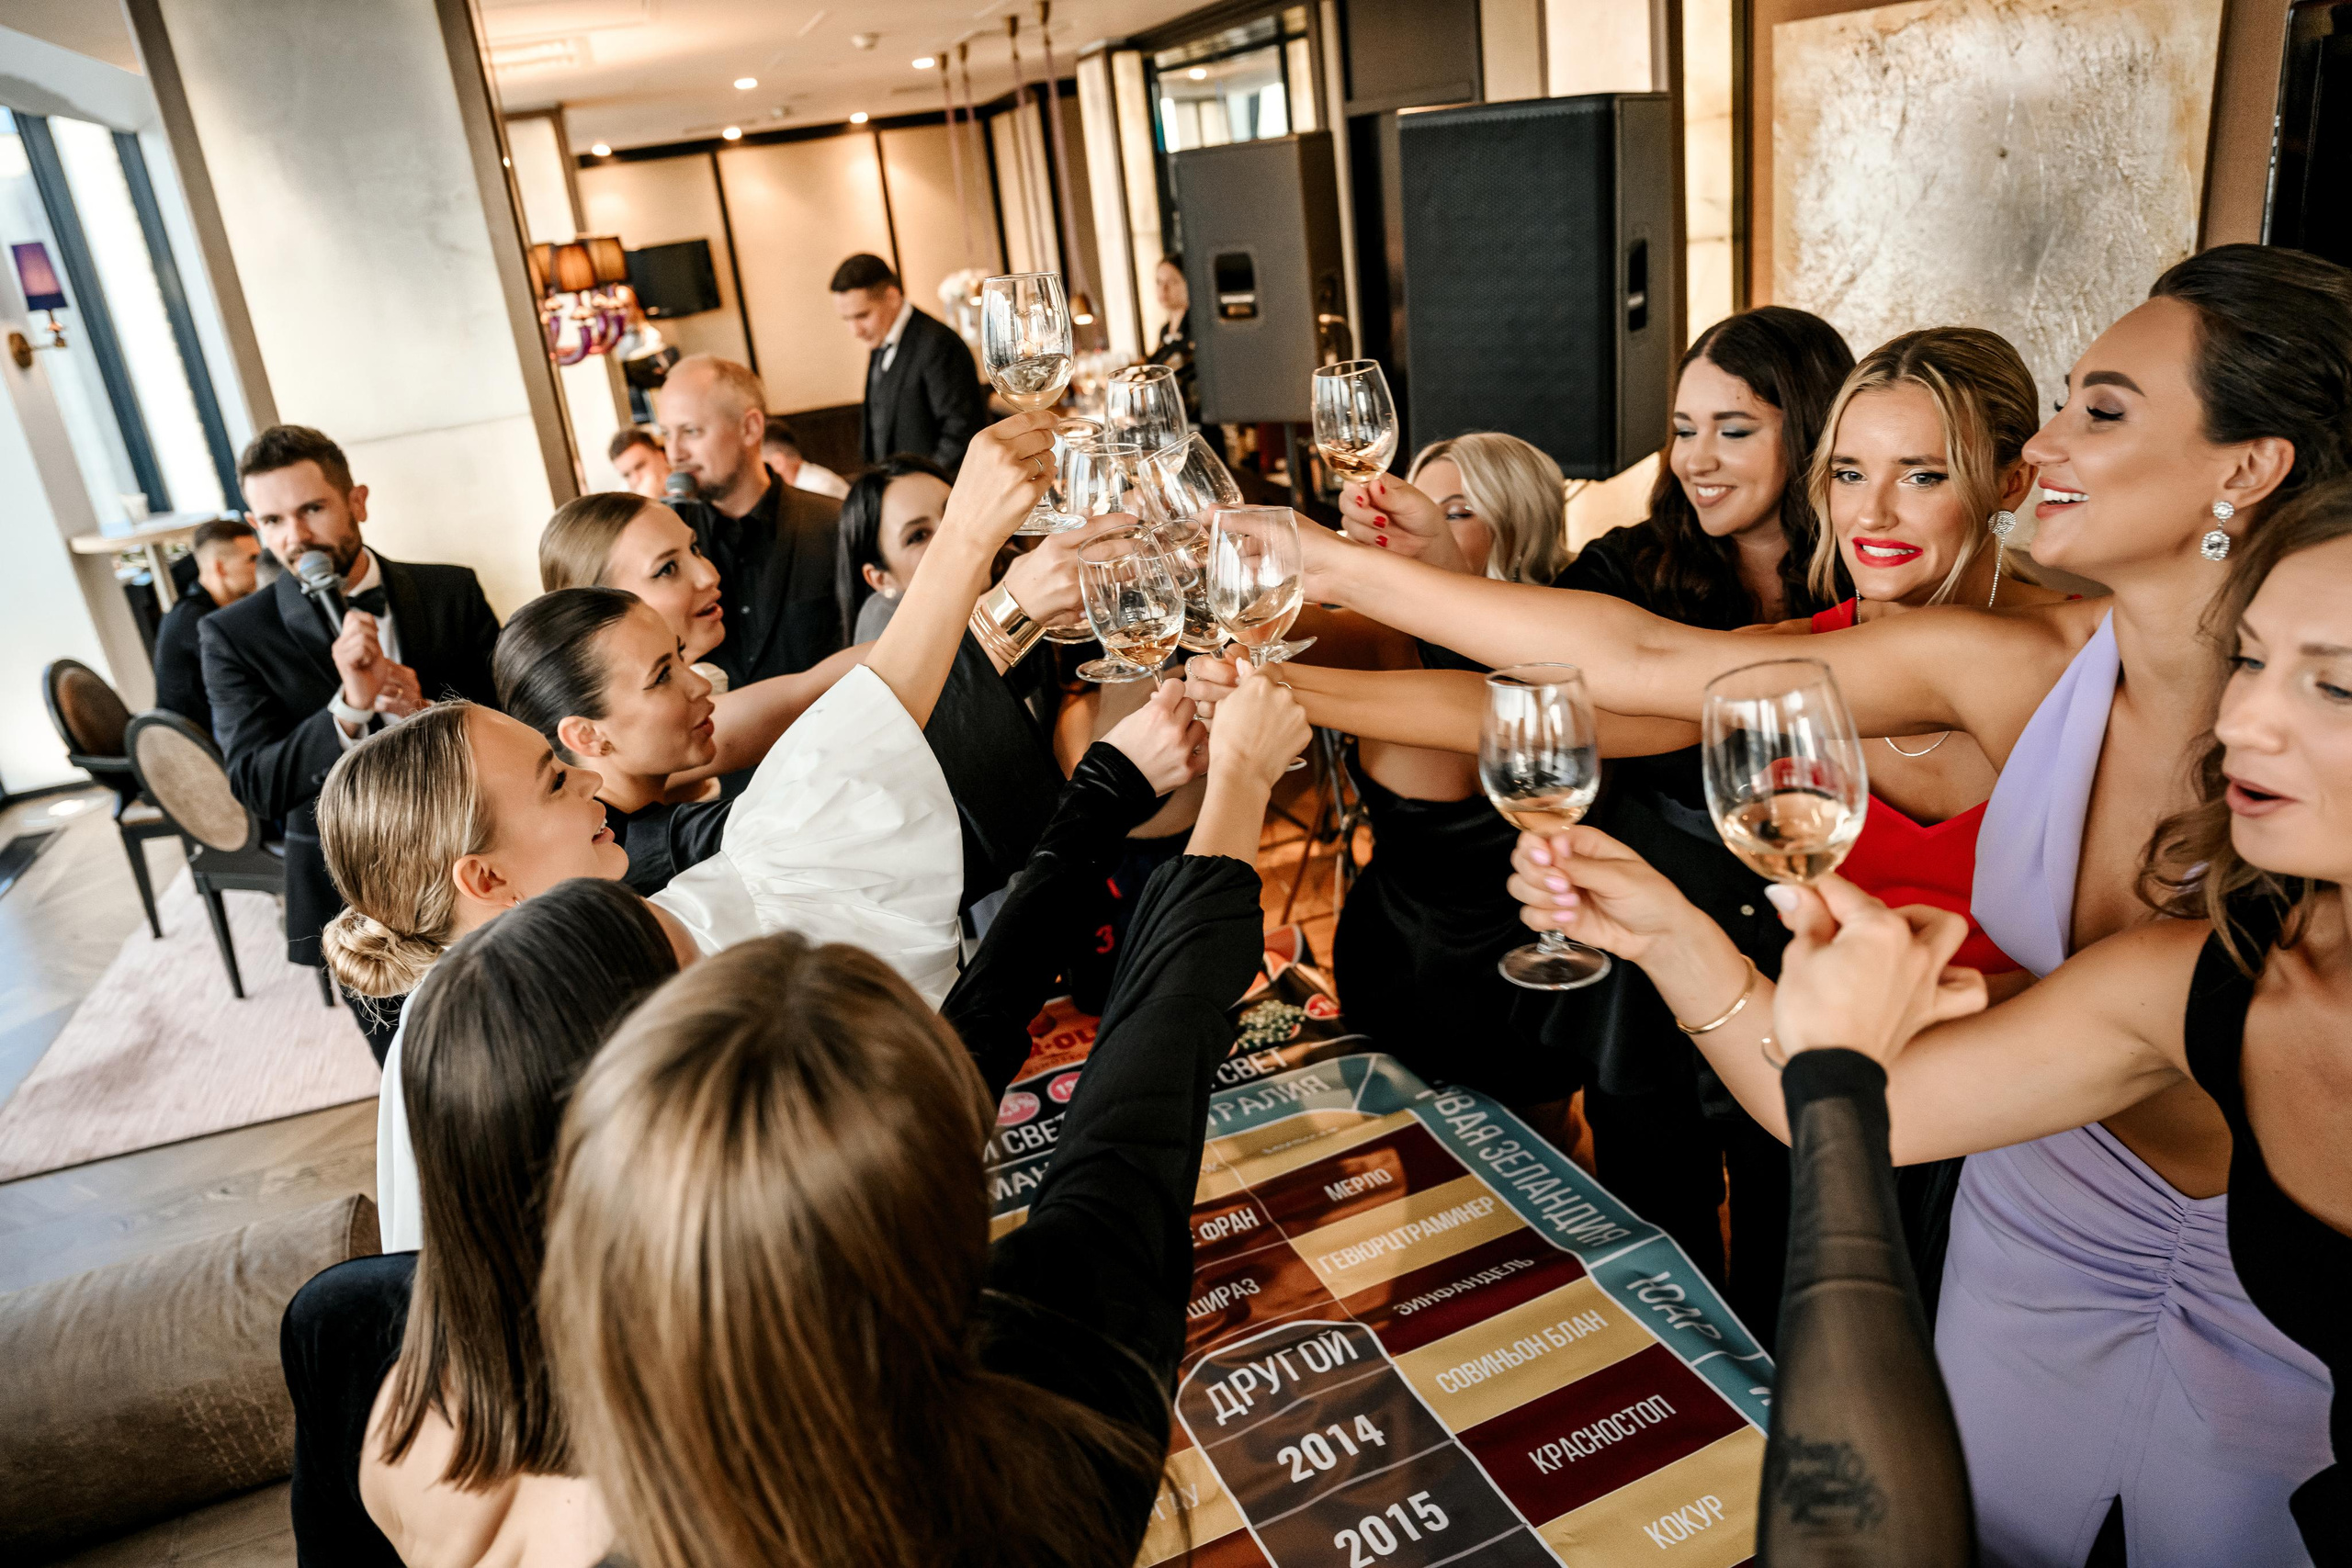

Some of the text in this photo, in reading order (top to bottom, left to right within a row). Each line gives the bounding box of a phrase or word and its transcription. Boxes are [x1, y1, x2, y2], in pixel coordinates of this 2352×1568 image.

[1216, 1046, 1287, 1085] СВЕТ
[1324, 1168, 1393, 1201] МЕРЛО
[1478, 1140, 1632, 1247] ЗЕЛАНДИЯ
[1198, 1207, 1261, 1241] ФРАН
[1317, 1196, 1495, 1274] ГЕВЮРЦТРАМИНЕР
[1186, 1278, 1261, 1319] ШИРАЗ
[1393, 1258, 1535, 1315] ЗИНФАНДЕЛЬ
[1626, 1271, 1722, 1340] ЮАР
[1205, 1329, 1359, 1427] ДРУГОЙ
[1435, 1309, 1609, 1393] СОВИНЬОН БЛАН
[1277, 1415, 1386, 1483] 2014
[1527, 1394, 1677, 1474] КРАСНОСТОП
[1333, 1490, 1450, 1568] 2015
[1643, 1495, 1725, 1551] КОКУР
